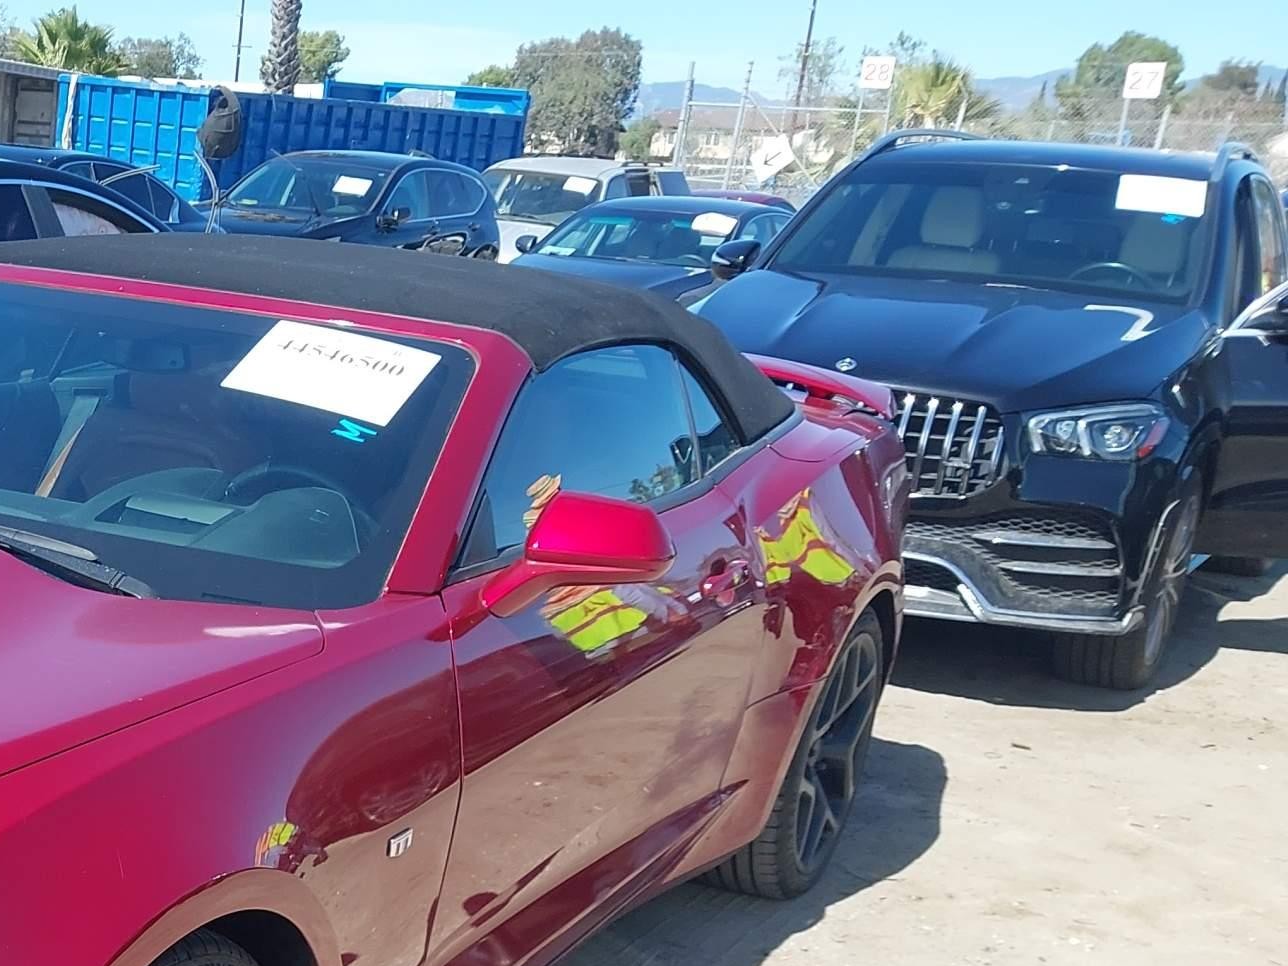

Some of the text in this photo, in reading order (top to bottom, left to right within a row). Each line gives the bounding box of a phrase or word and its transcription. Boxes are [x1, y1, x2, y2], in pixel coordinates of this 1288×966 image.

[864, 63, 890, 81] 28
[1128, 71, 1160, 90] 27
[276, 338, 406, 377] 44546500
